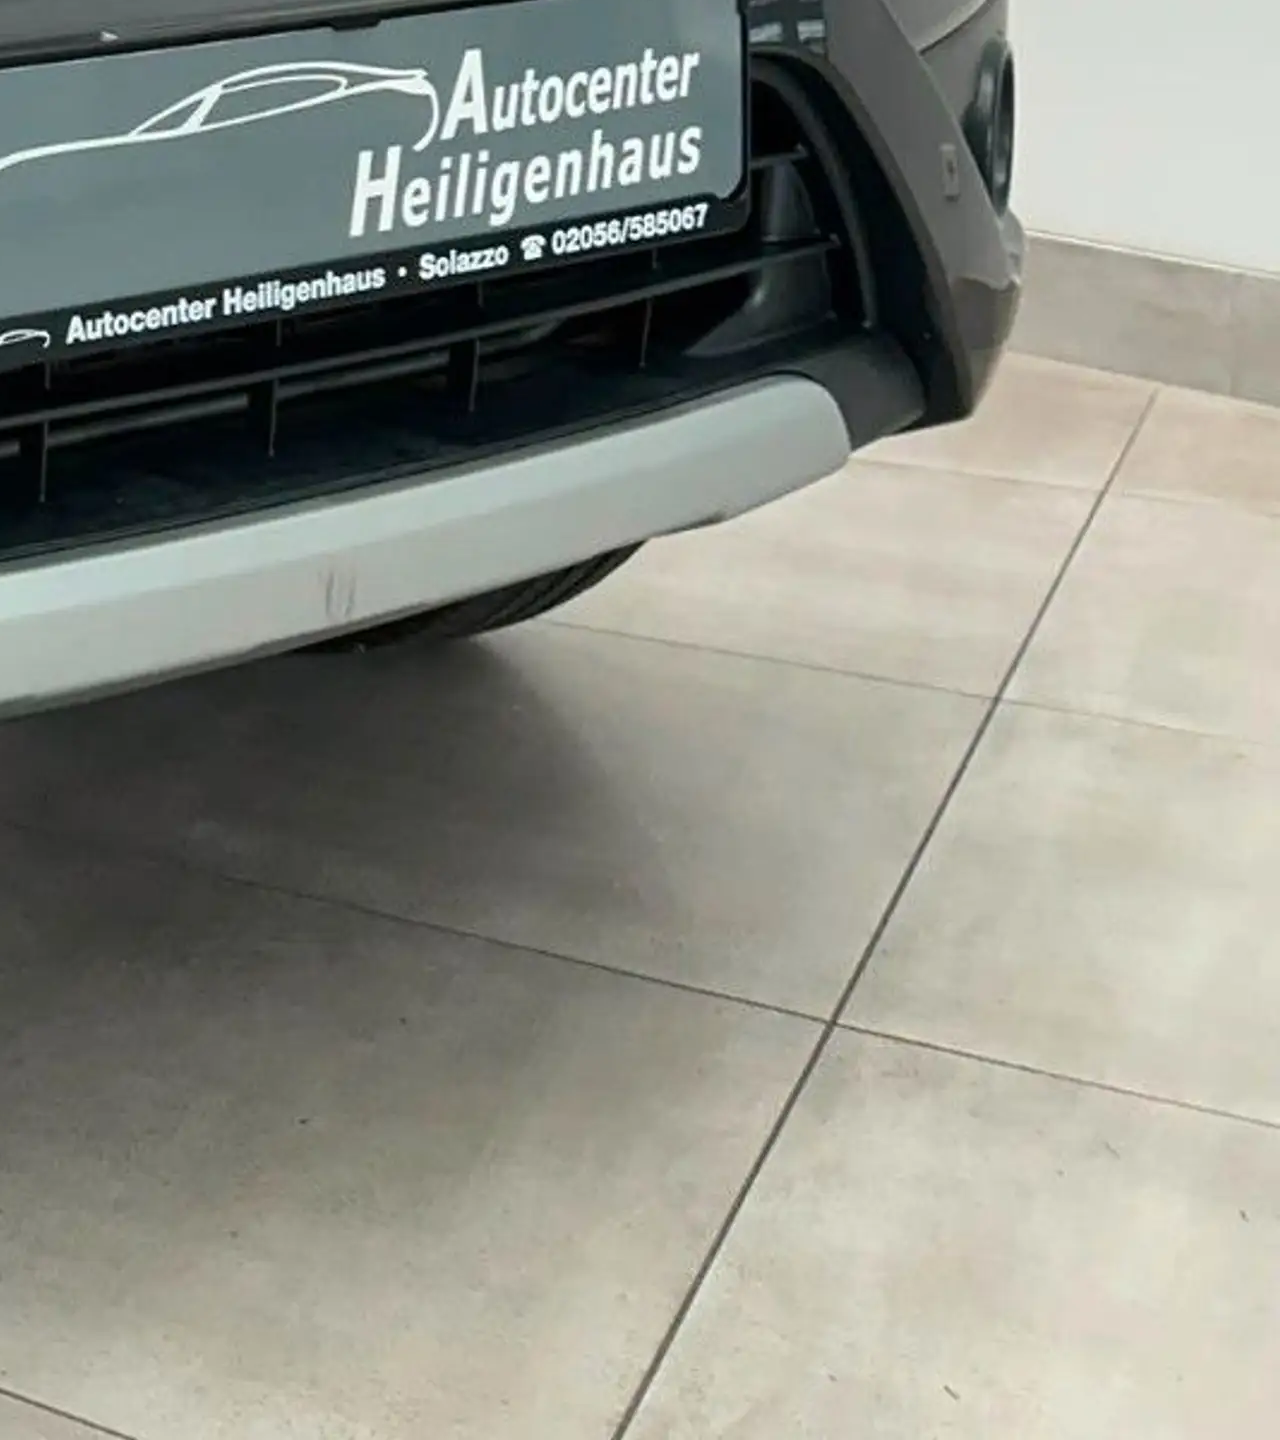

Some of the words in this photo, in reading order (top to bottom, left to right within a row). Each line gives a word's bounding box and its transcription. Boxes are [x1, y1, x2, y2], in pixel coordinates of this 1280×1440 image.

[440, 47, 701, 140] Autocenter
[349, 126, 702, 238] Heiligenhaus
[65, 296, 217, 345] Autocenter
[222, 267, 386, 310] Heiligenhaus
[418, 245, 510, 280] Solazzo
[551, 203, 709, 255] 02056/585067
